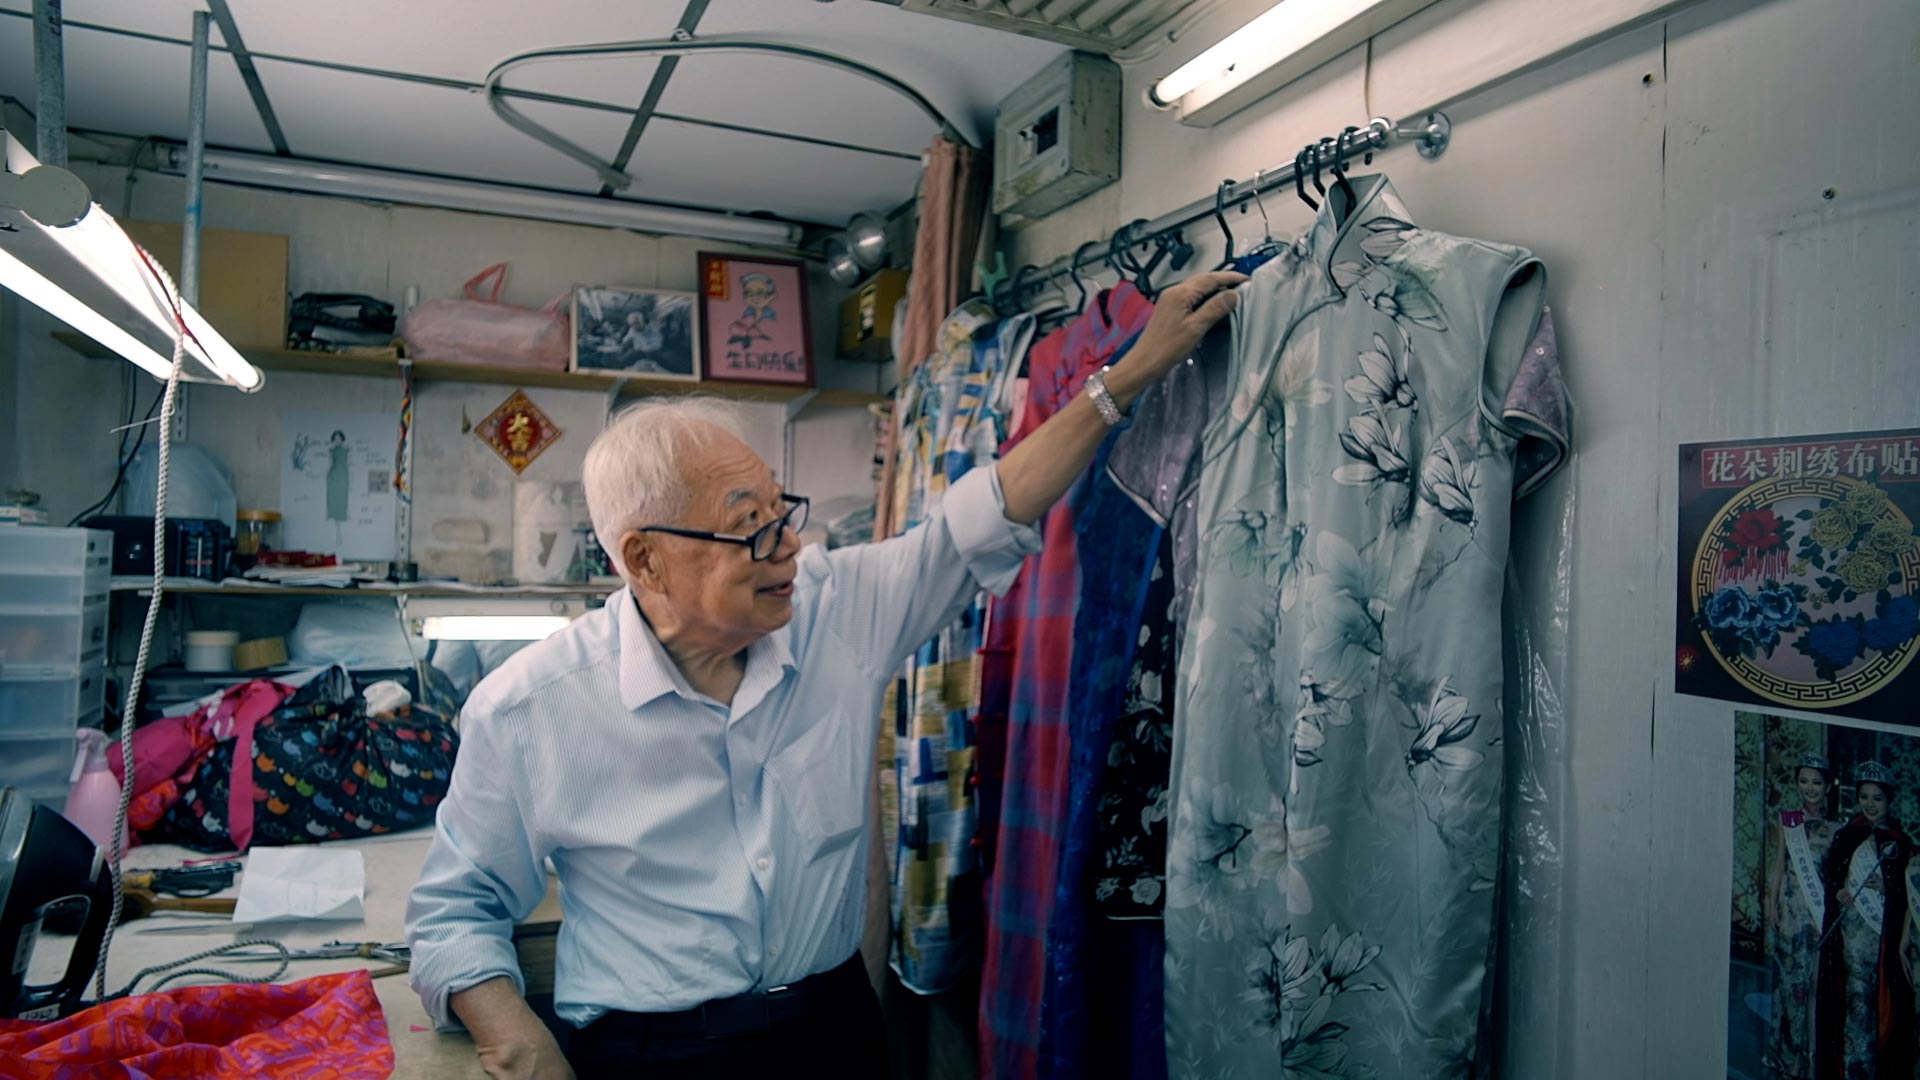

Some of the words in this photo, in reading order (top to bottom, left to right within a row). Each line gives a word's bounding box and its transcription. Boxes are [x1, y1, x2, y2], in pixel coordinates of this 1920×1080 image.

[1707, 440, 1919, 482] 花朵刺绣布贴
